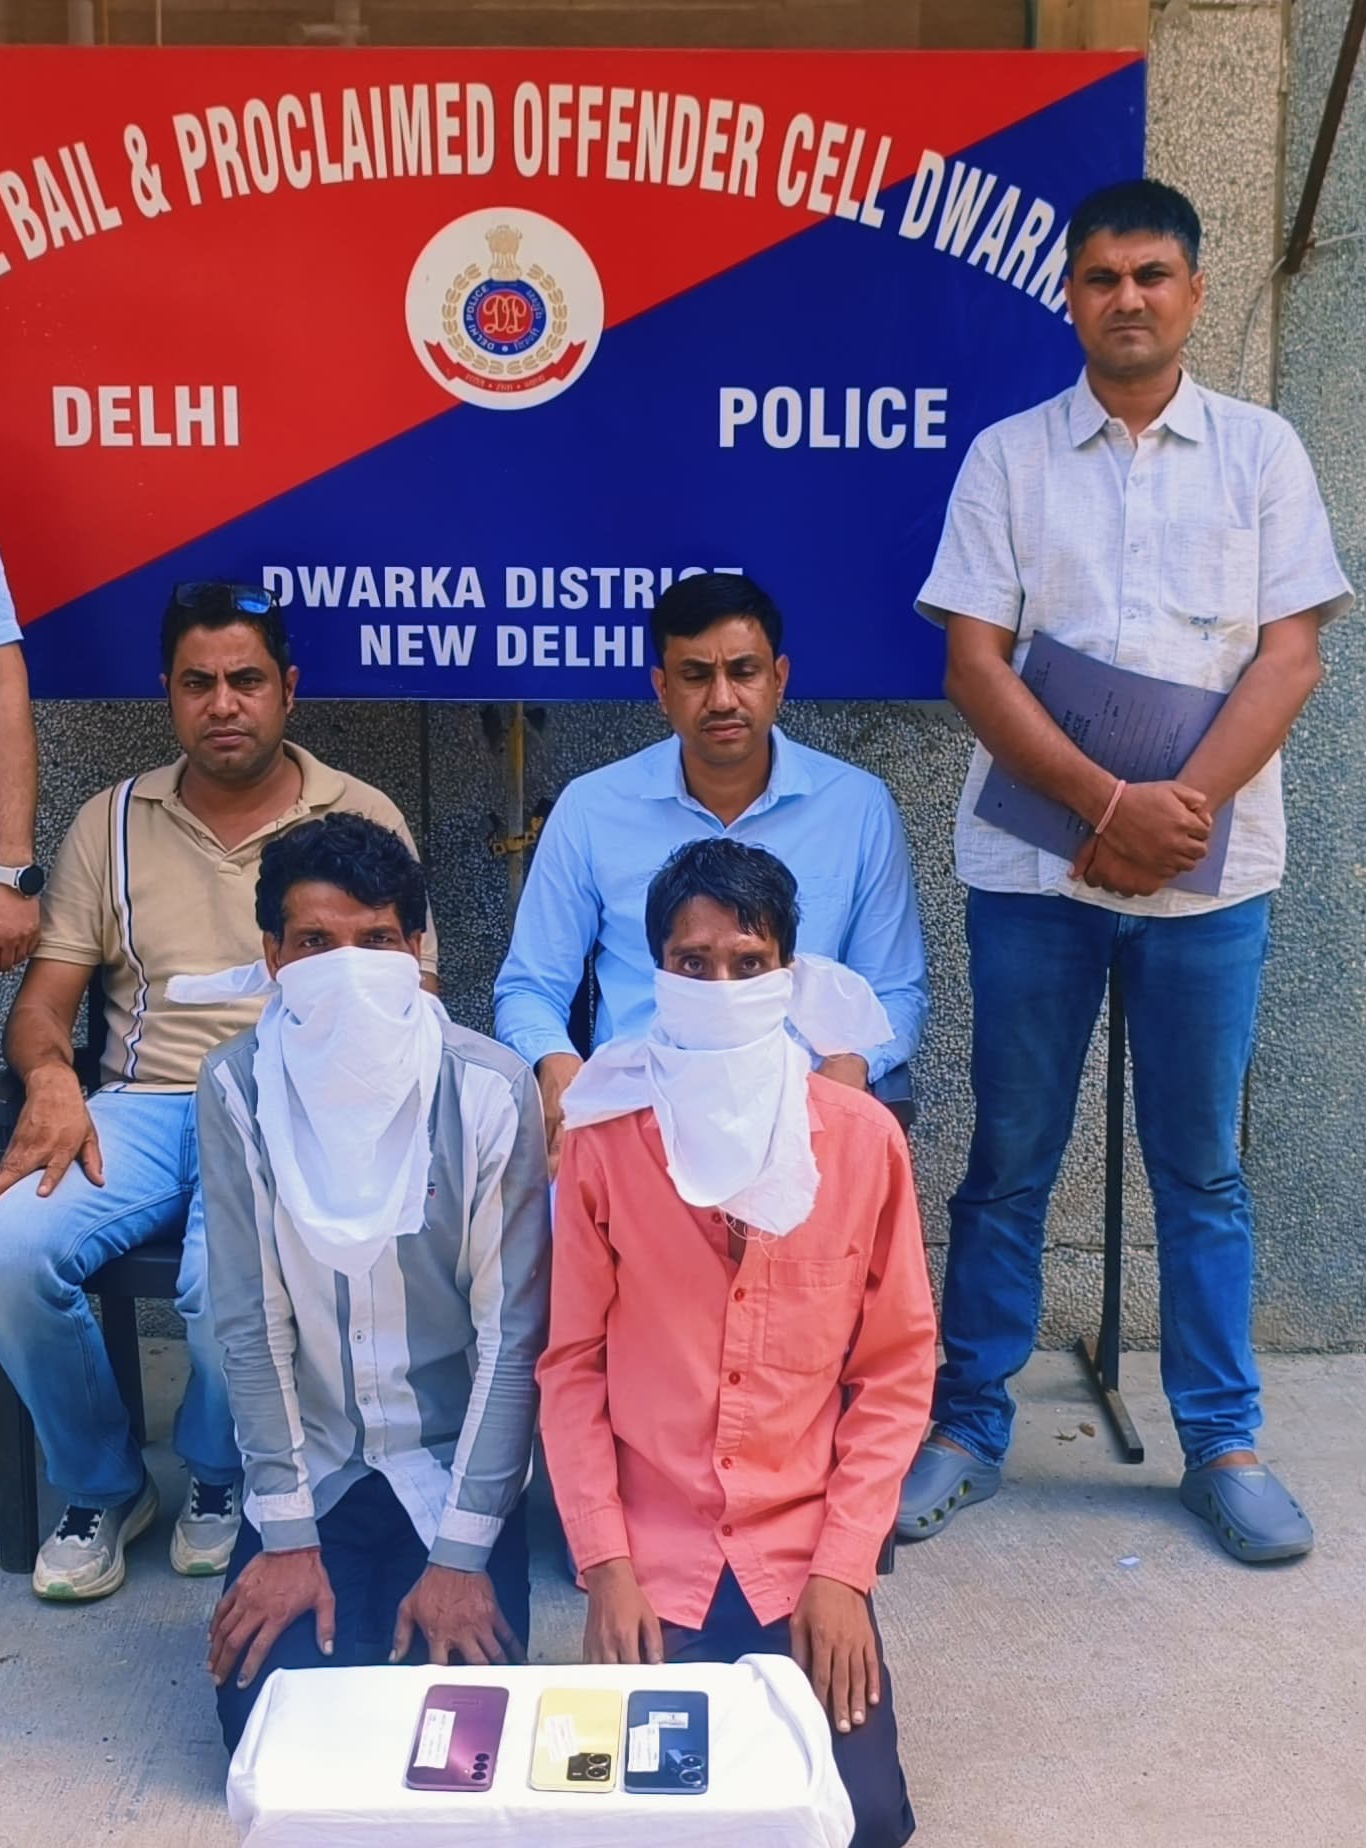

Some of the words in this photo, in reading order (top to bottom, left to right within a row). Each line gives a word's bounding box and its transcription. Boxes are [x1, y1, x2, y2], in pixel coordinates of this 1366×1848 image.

[123, 124, 172, 218] &
[172, 82, 495, 206] PROCLAIMED
[513, 81, 765, 197] OFFENDER
[777, 113, 892, 228] CELL
[898, 148, 1074, 325] DWARK
[466, 285, 489, 321] POLICE
[52, 386, 239, 447] DELHI
[719, 387, 948, 449] POLICE
[262, 566, 486, 608] DWARKA
[506, 566, 744, 609] DISTRI
[360, 625, 477, 666] NEW
[497, 625, 645, 667] DELHI
